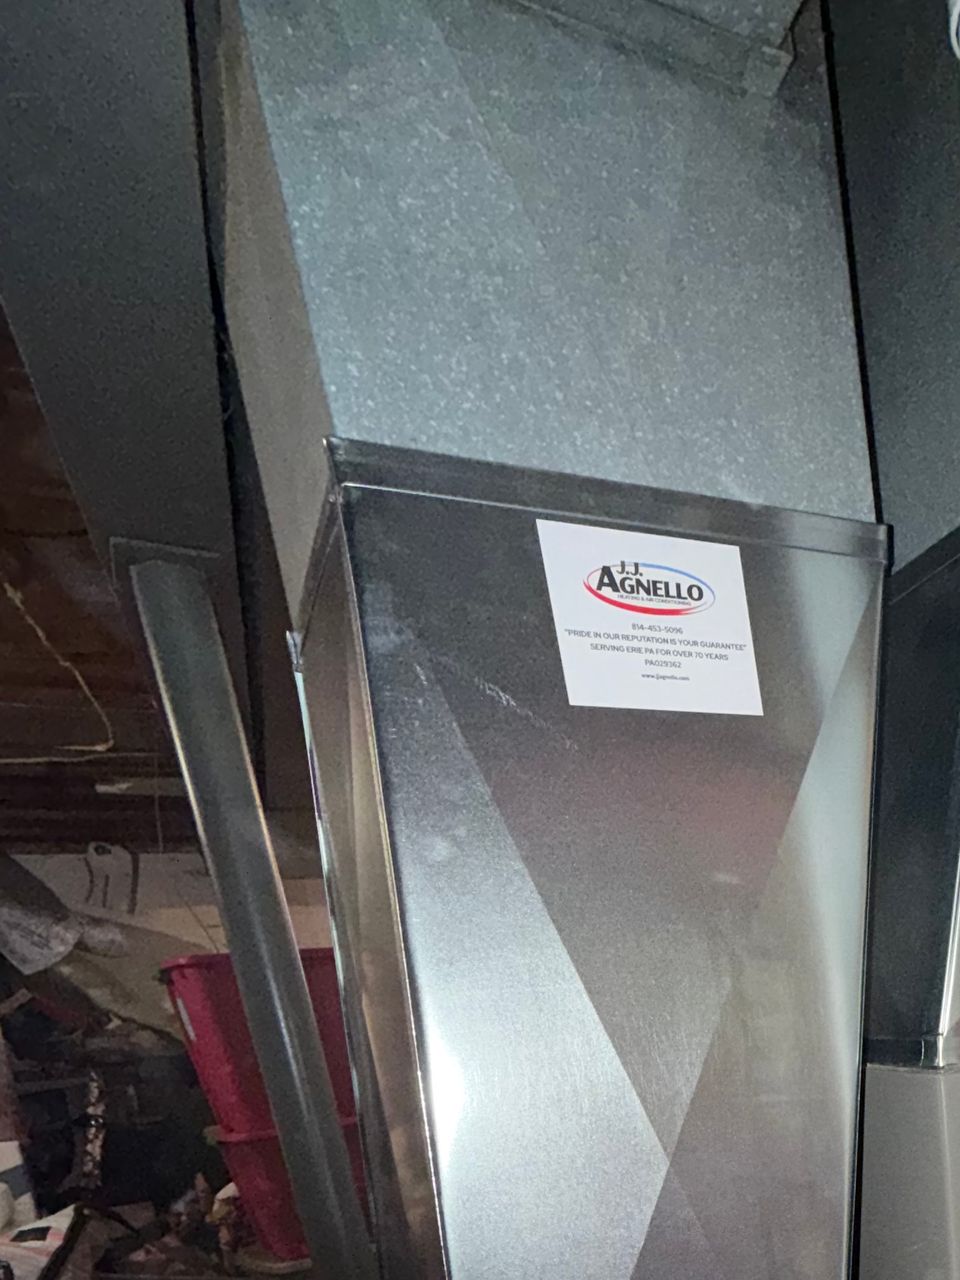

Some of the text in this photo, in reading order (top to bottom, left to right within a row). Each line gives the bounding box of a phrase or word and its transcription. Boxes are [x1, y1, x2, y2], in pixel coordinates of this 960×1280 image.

[616, 560, 643, 577] J.J.
[596, 565, 704, 602] AGNELLO
[631, 623, 683, 634] 814-453-5096
[602, 632, 620, 641] OUR
[621, 634, 669, 645] REPUTATION
[678, 638, 698, 648] YOUR
[590, 643, 625, 653] SERVING
[626, 646, 643, 654] ERIE
[655, 648, 671, 656] FOR
[672, 650, 693, 658] OVER
[705, 652, 729, 661] YEARS
